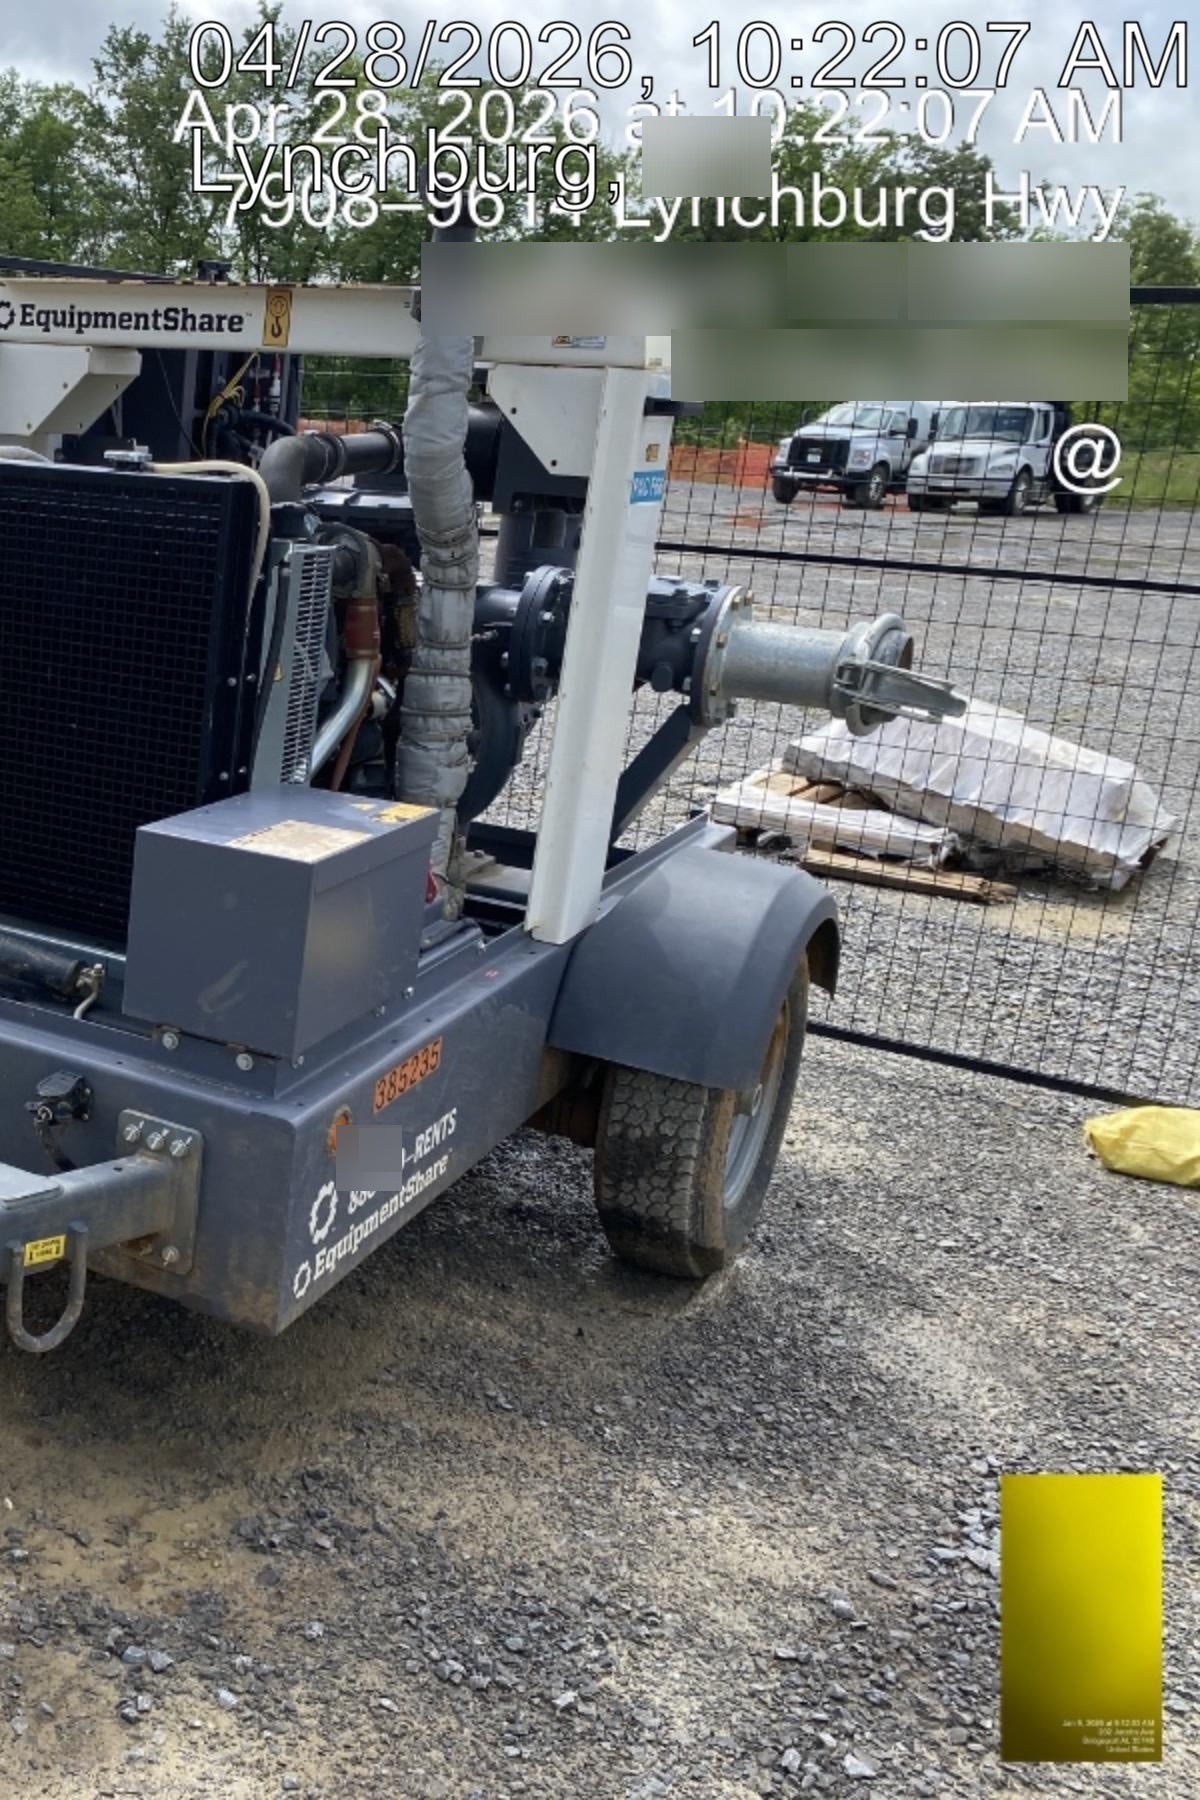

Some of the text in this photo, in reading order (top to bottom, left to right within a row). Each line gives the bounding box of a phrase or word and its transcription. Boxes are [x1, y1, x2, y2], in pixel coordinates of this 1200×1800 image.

[19, 303, 244, 334] EquipmentShare
[374, 1041, 440, 1109] 385235
[313, 1154, 449, 1281] EquipmentShare
